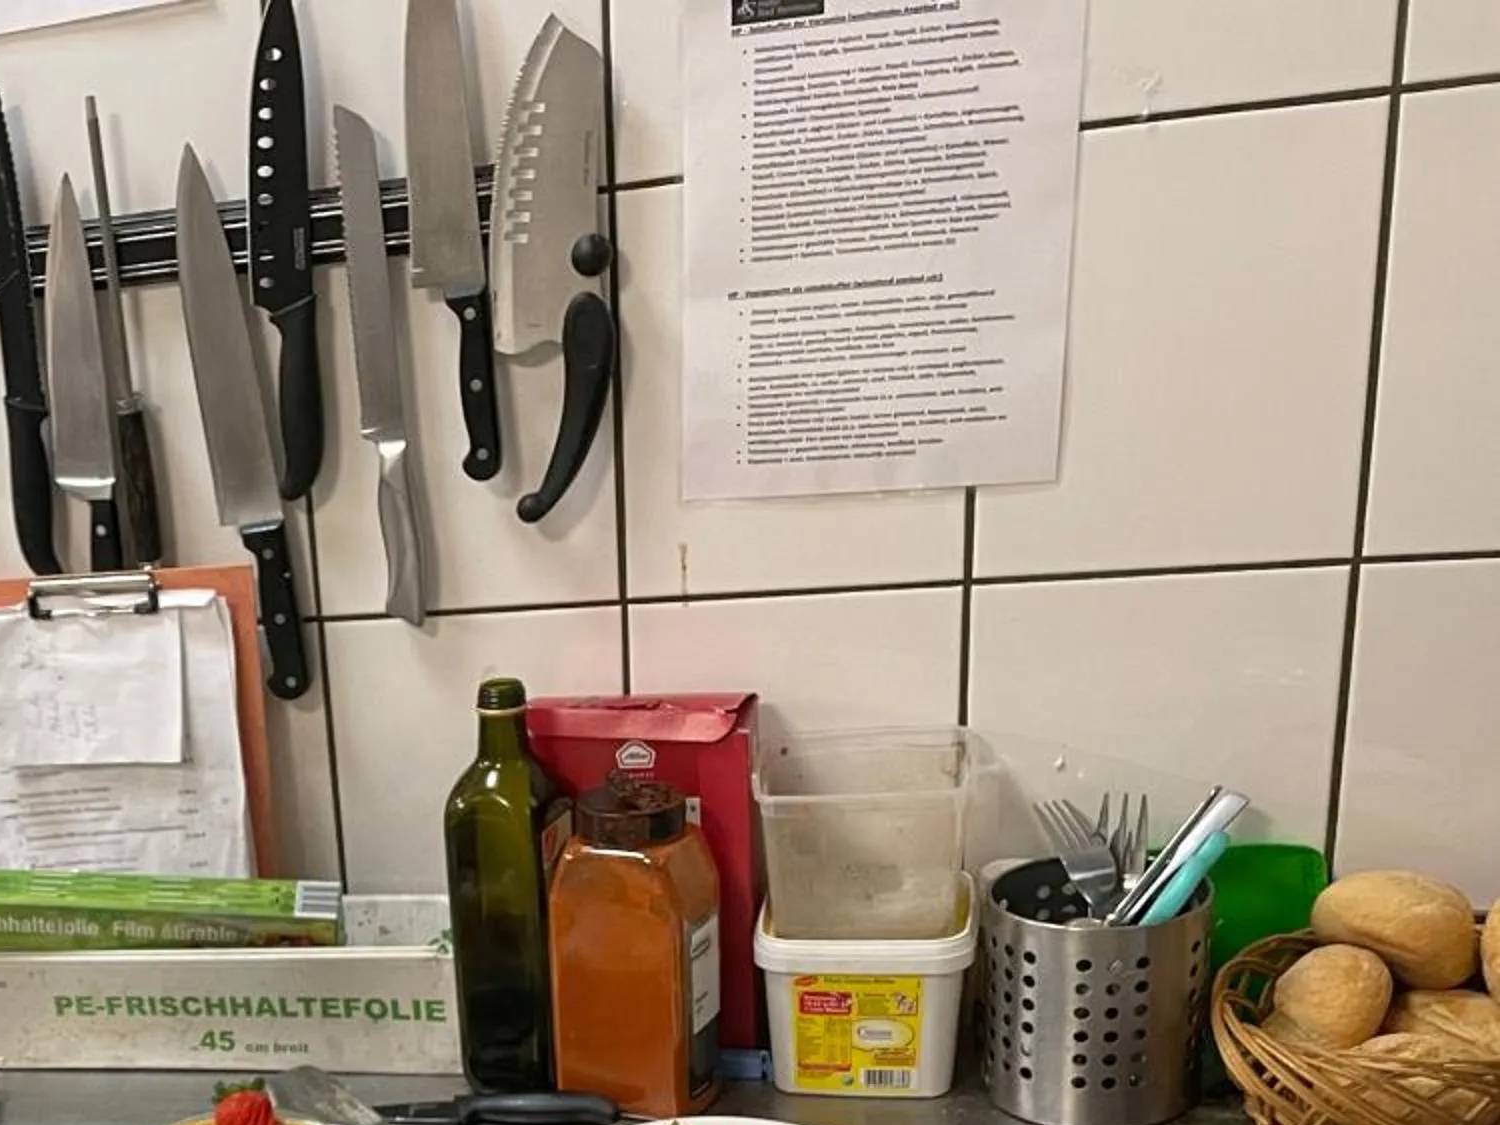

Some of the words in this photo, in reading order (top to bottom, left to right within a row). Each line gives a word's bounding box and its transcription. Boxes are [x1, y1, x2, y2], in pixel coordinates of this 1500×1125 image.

[112, 918, 155, 939] Film
[54, 994, 448, 1023] PE-FRISCHHALTEFOLIE
[200, 1029, 236, 1053] 45
